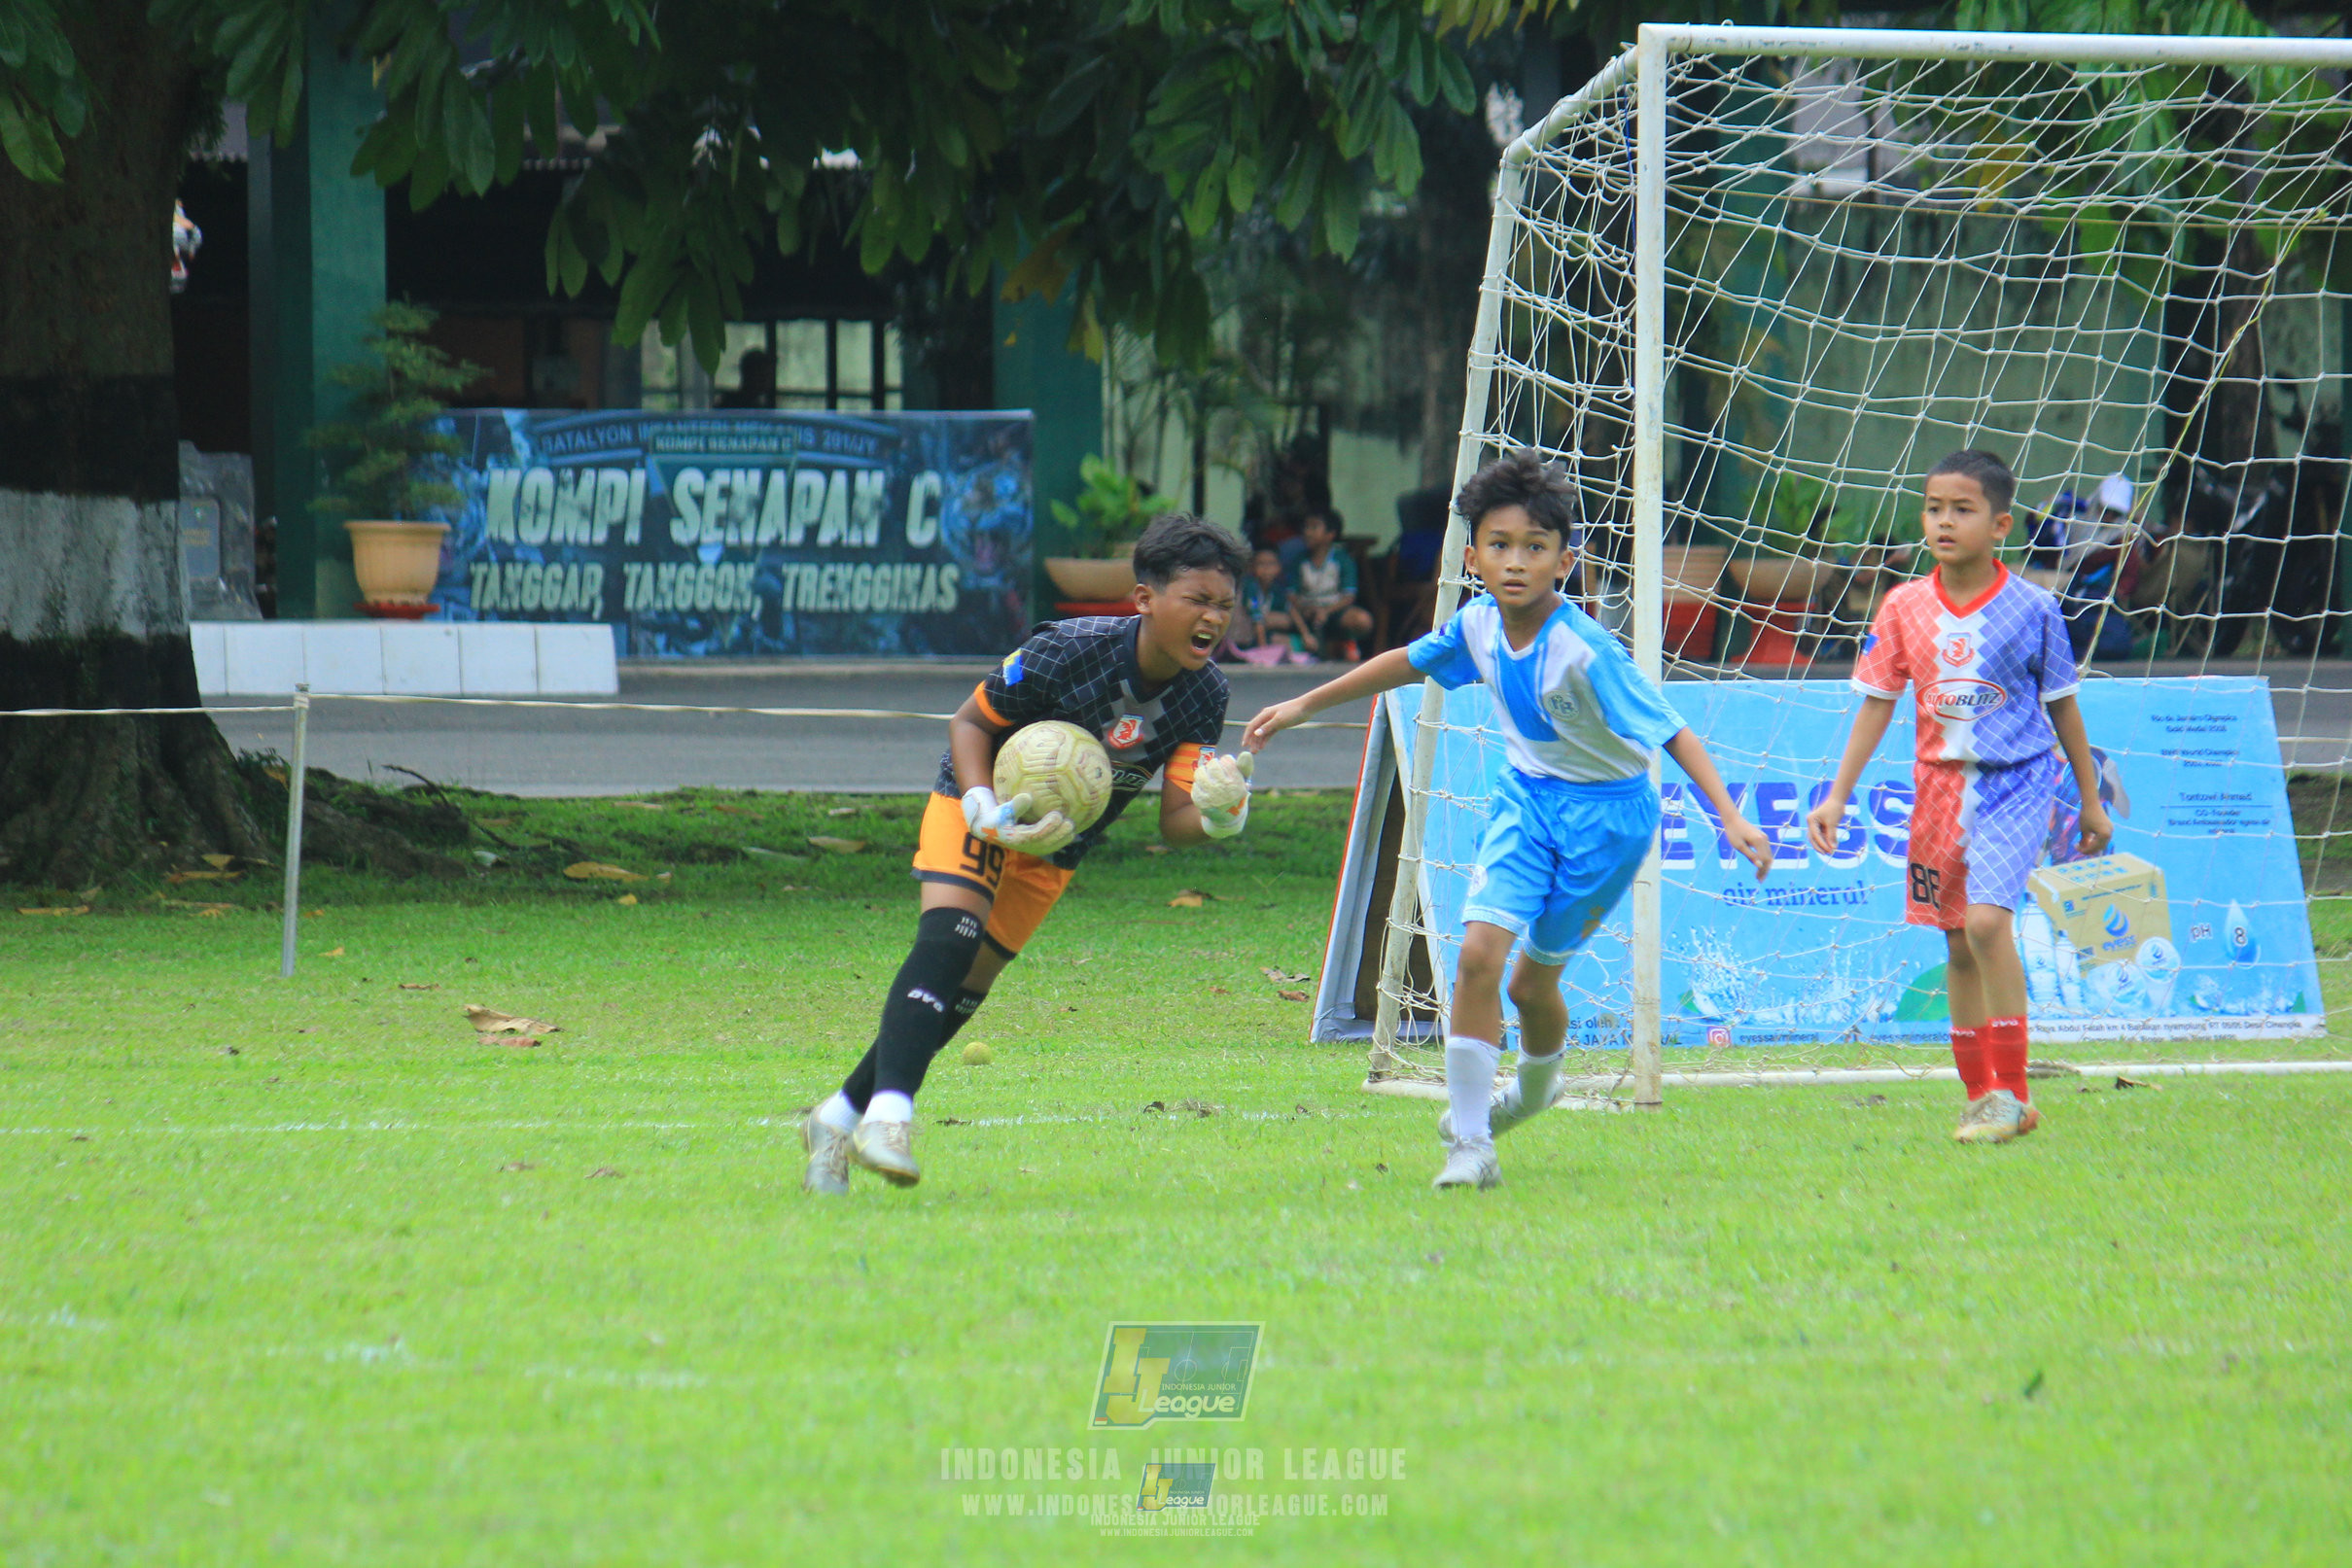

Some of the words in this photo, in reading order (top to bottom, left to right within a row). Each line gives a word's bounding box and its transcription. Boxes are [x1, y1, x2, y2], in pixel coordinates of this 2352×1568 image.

[541, 426, 632, 454] BATALYON
[486, 467, 646, 546] KOMPI
[670, 467, 886, 547] SENAPAN
[906, 470, 942, 548] C
[469, 561, 604, 620] TANGGAP,
[623, 561, 763, 620] TANGGON,
[782, 562, 961, 613] TRENGGINAS
[960, 832, 1005, 889] 99
[1760, 881, 1868, 906] mineral
[2192, 923, 2213, 943] pH
[2234, 926, 2248, 948] 8
